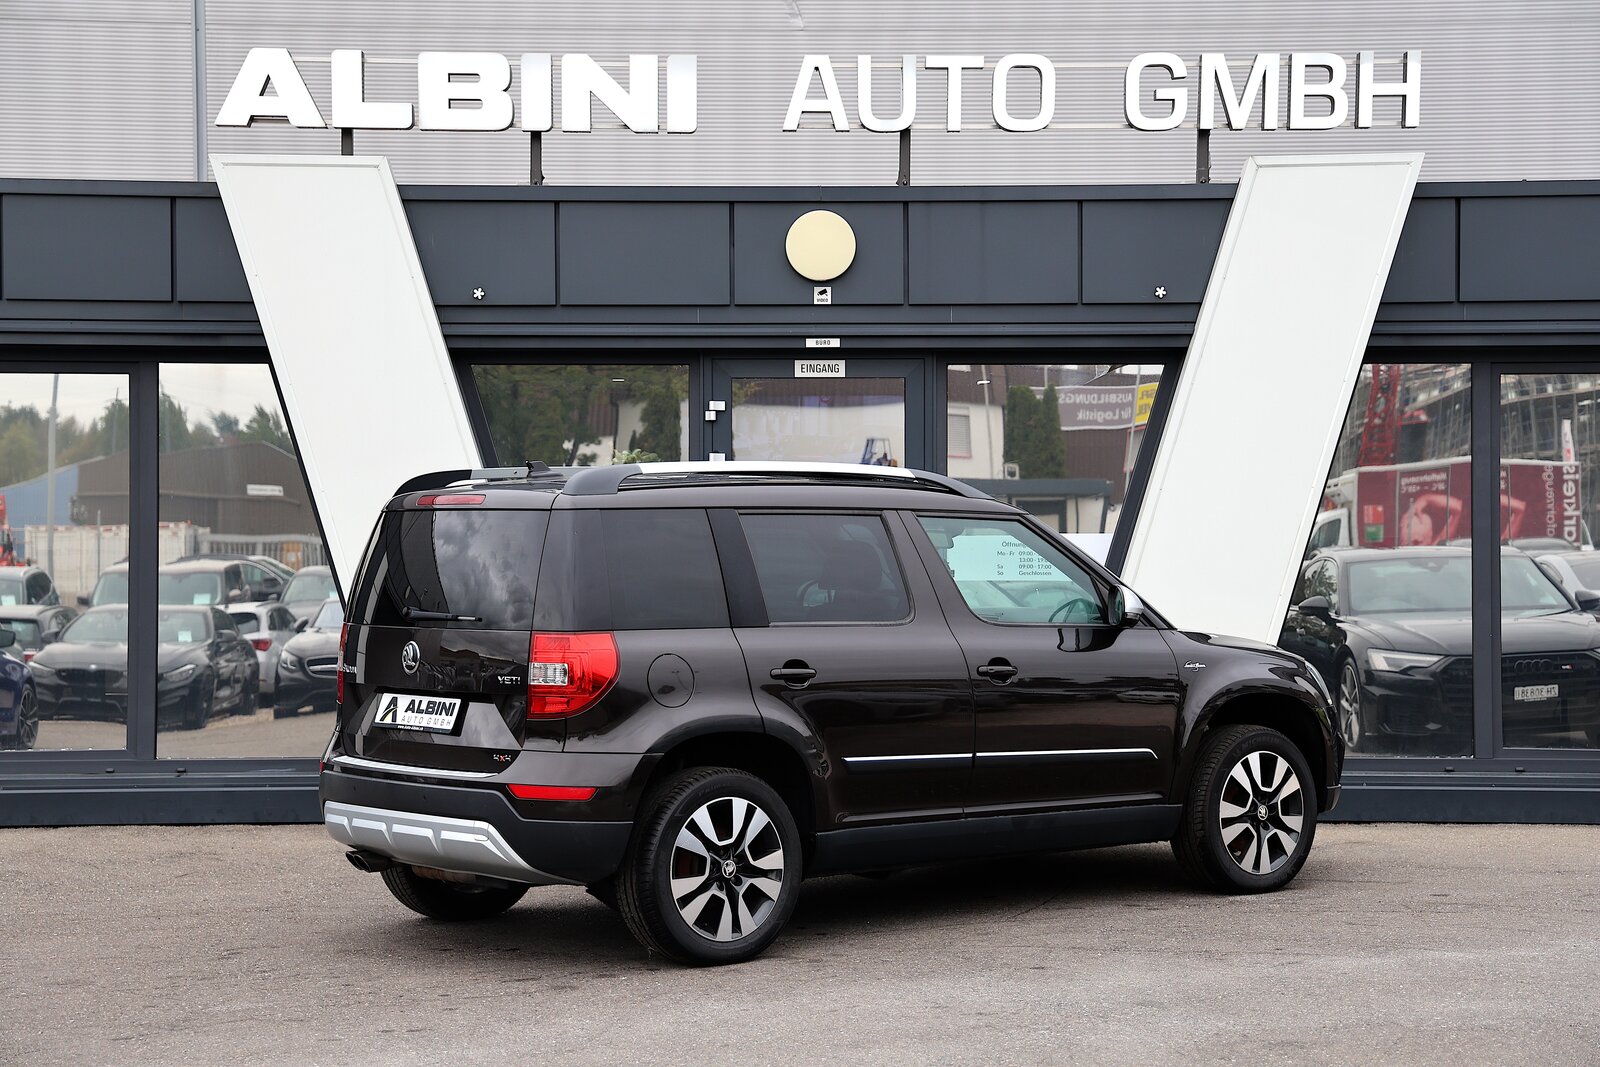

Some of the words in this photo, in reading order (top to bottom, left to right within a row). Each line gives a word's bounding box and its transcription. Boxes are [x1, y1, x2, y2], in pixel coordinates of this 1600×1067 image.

[214, 47, 698, 134] ALBINI
[782, 52, 1056, 133] AUTO
[1124, 49, 1423, 132] GMBH
[800, 363, 840, 373] EINGANG
[497, 675, 521, 685] YETI
[404, 699, 457, 716] ALBINI
[401, 716, 424, 724] AUTO
[426, 717, 452, 727] GMBH
[493, 754, 512, 762] 4x4
